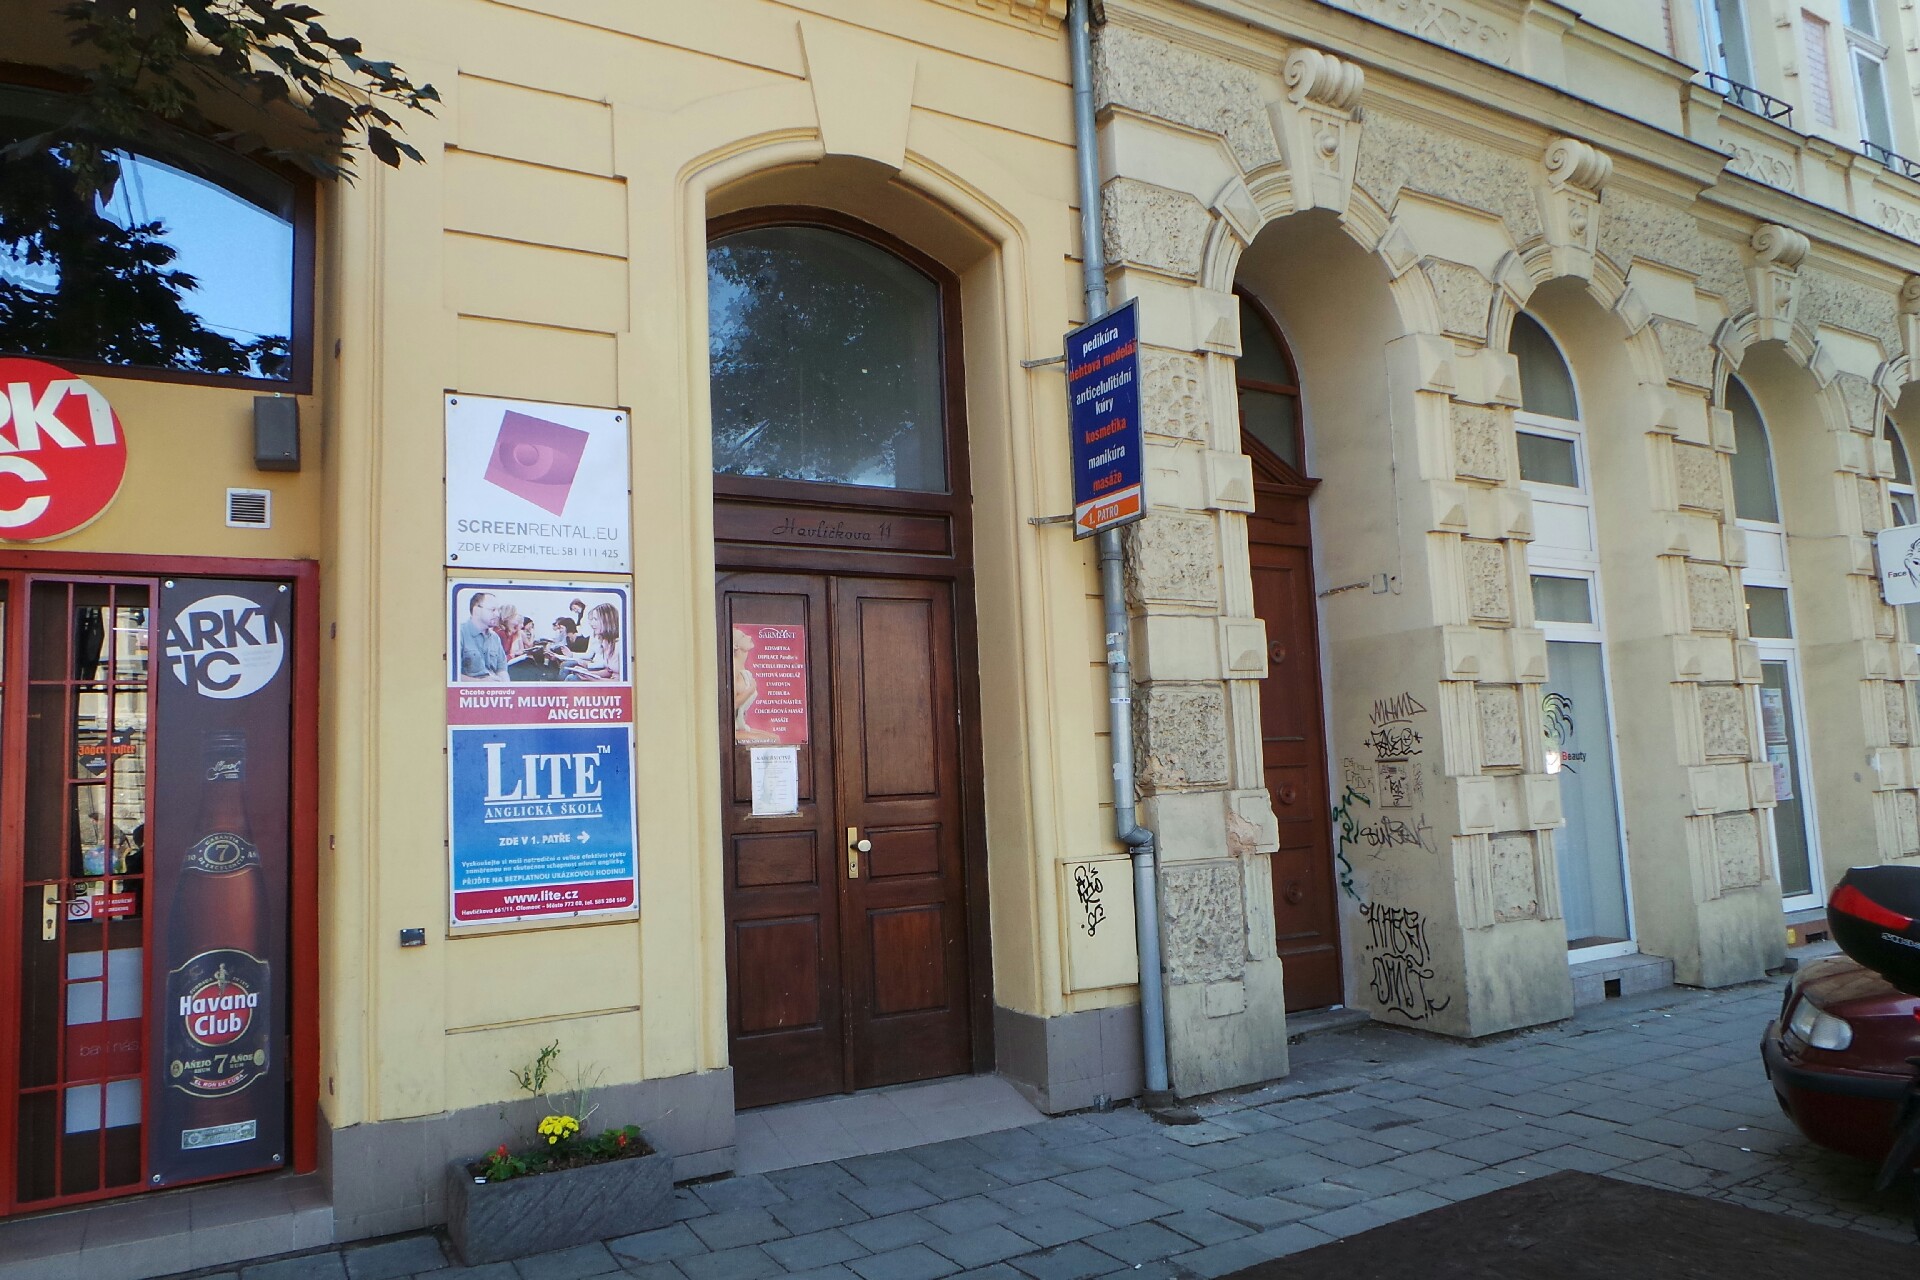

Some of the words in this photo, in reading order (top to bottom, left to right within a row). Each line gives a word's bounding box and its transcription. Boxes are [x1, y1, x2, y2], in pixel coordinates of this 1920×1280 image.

[1082, 327, 1119, 358] pedikúra
[1103, 338, 1138, 366] modeláž
[1076, 366, 1132, 406] anticelulitidní
[1095, 397, 1114, 416] kúry
[1085, 417, 1127, 445] kosmetika
[1088, 443, 1126, 470] manikúra
[1093, 469, 1123, 492] masáže
[1097, 504, 1119, 522] PATRO
[457, 519, 618, 541] SCREENRENTAL.EU
[879, 520, 892, 541] 11
[562, 547, 577, 557] 581
[601, 549, 619, 558] 425
[459, 696, 514, 709] MLUVIT,
[518, 696, 569, 708] MLUVIT,
[574, 695, 622, 707] MLUVIT
[547, 708, 623, 720] ANGLICKY?
[1561, 751, 1587, 763] Beauty
[485, 802, 553, 819] ANGLICKÁ
[561, 802, 603, 815] ŠKOLA
[499, 837, 519, 847] ZDE
[521, 836, 529, 845] V
[531, 836, 540, 845] 1.
[542, 832, 571, 844] PATŘE
[215, 844, 229, 862] 7
[503, 889, 579, 905] www.lite.cz
[180, 992, 258, 1016] Havana
[194, 1012, 242, 1036] Club
[214, 1053, 229, 1074] 7
